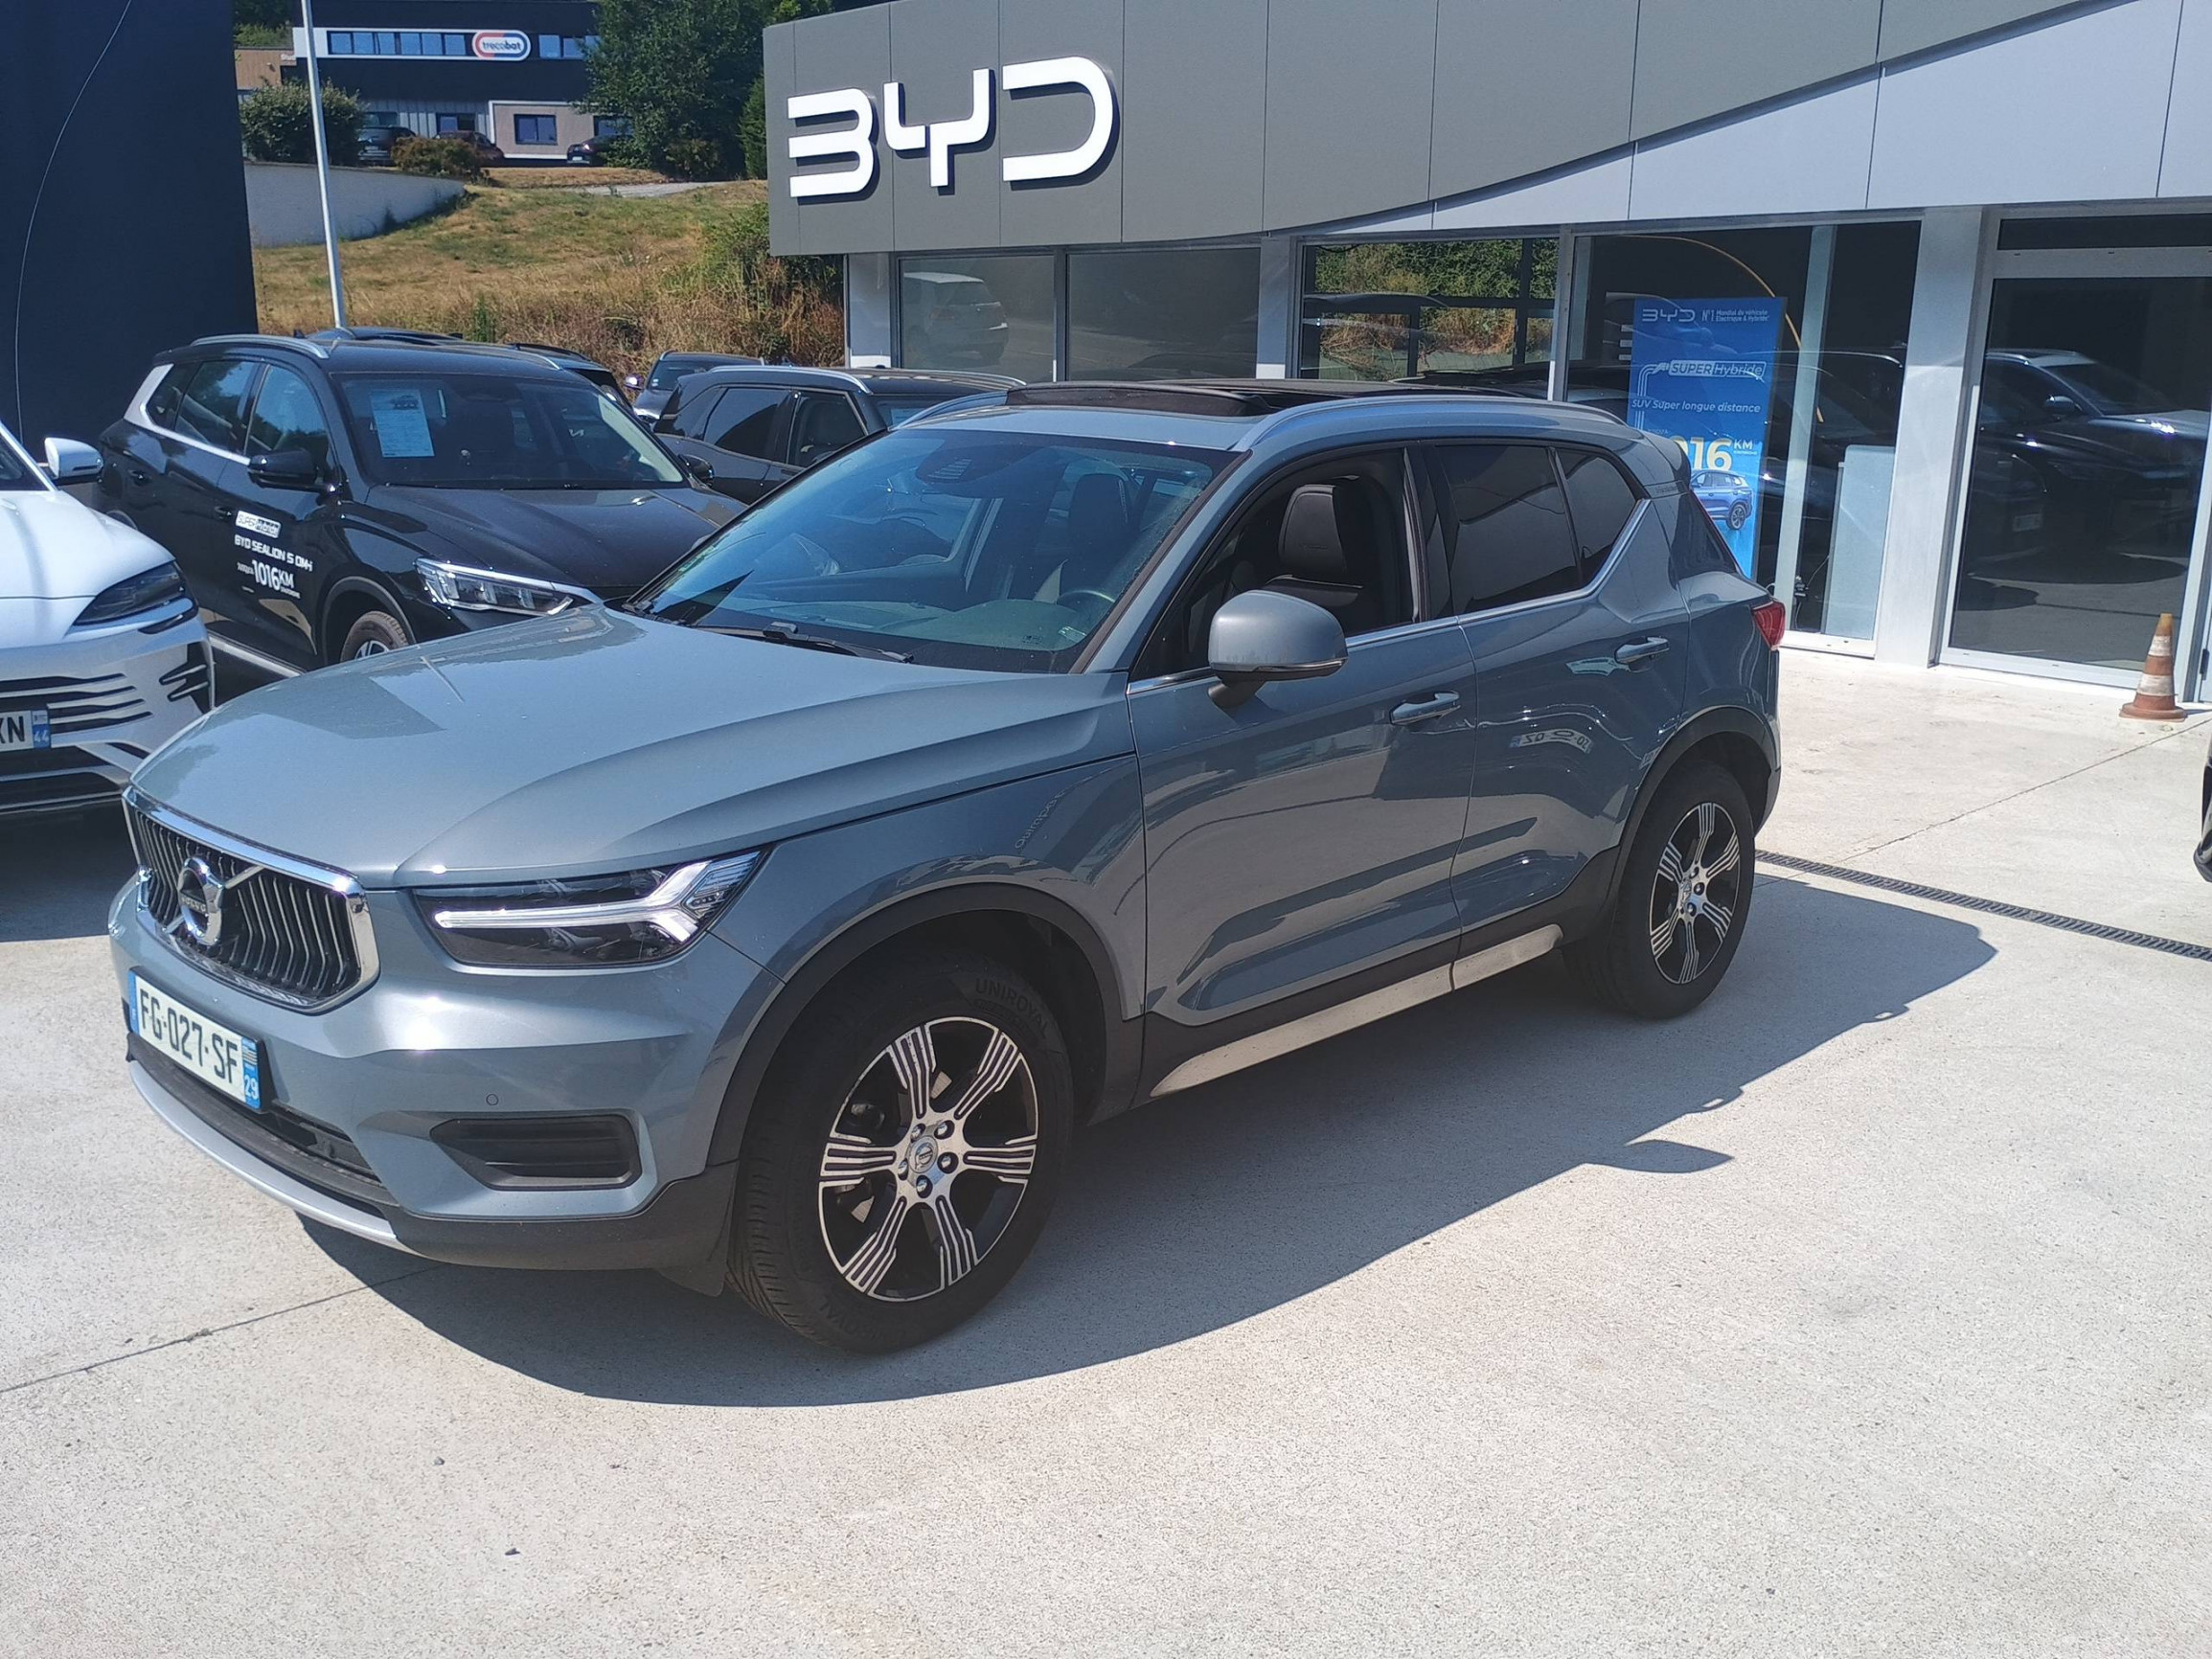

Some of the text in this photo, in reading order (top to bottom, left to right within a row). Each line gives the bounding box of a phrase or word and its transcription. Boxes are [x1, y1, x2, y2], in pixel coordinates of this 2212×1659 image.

[787, 56, 1115, 197] BYD
[1642, 308, 1696, 323] BYD
[1672, 362, 1763, 376] SUPER Hybride
[1631, 398, 1761, 413] SUV Super longue distance
[1733, 439, 1753, 450] KM
[252, 540, 285, 561] SEALION
[251, 559, 281, 591] 1016
[279, 568, 295, 589] KM
[975, 977, 1048, 1039] UNIROYAL
[140, 988, 239, 1084] FG-027-SF
[243, 1074, 259, 1100] 29
